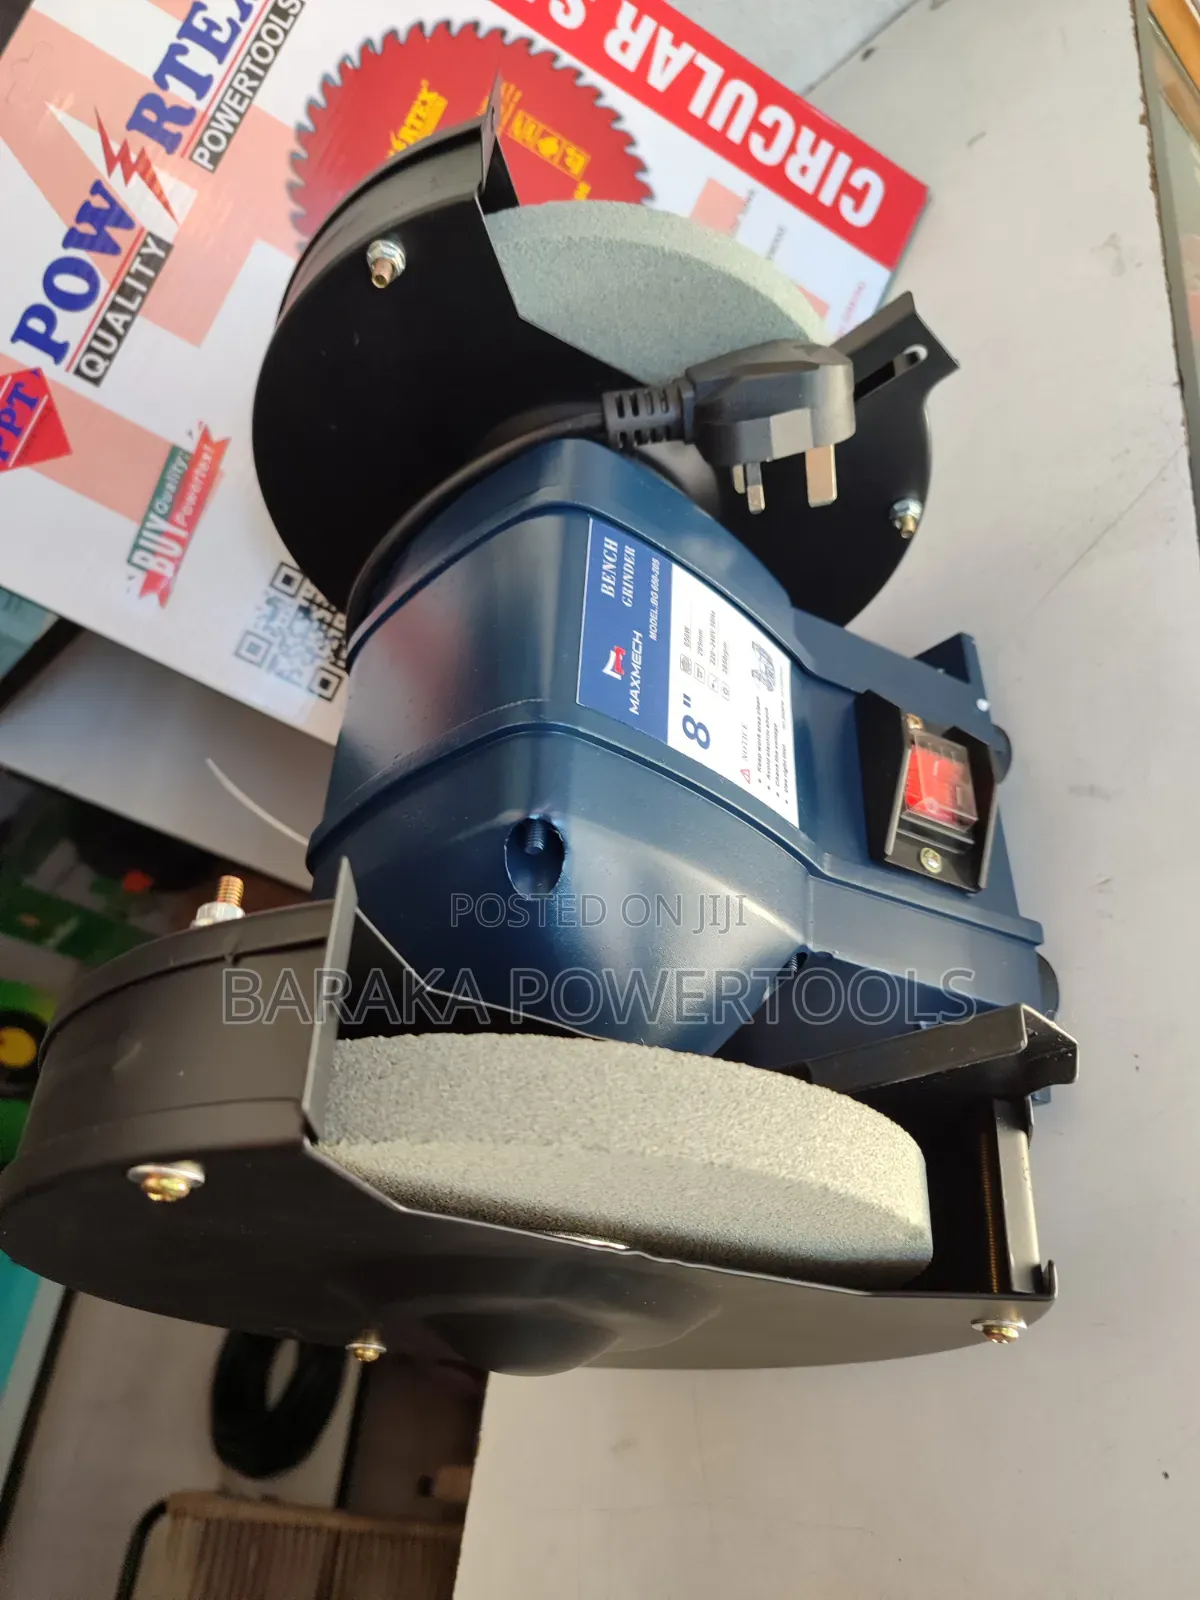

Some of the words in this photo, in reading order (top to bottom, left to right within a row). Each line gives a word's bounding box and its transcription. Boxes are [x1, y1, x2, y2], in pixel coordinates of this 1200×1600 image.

[603, 0, 886, 228] CIRCULAR
[79, 236, 166, 379] QUALITY
[191, 0, 302, 171] POWERTOOLS
[129, 511, 188, 577] BUY
[601, 537, 619, 599] BENCH
[621, 545, 637, 608] GRINDER
[629, 630, 643, 716] MAXMECH
